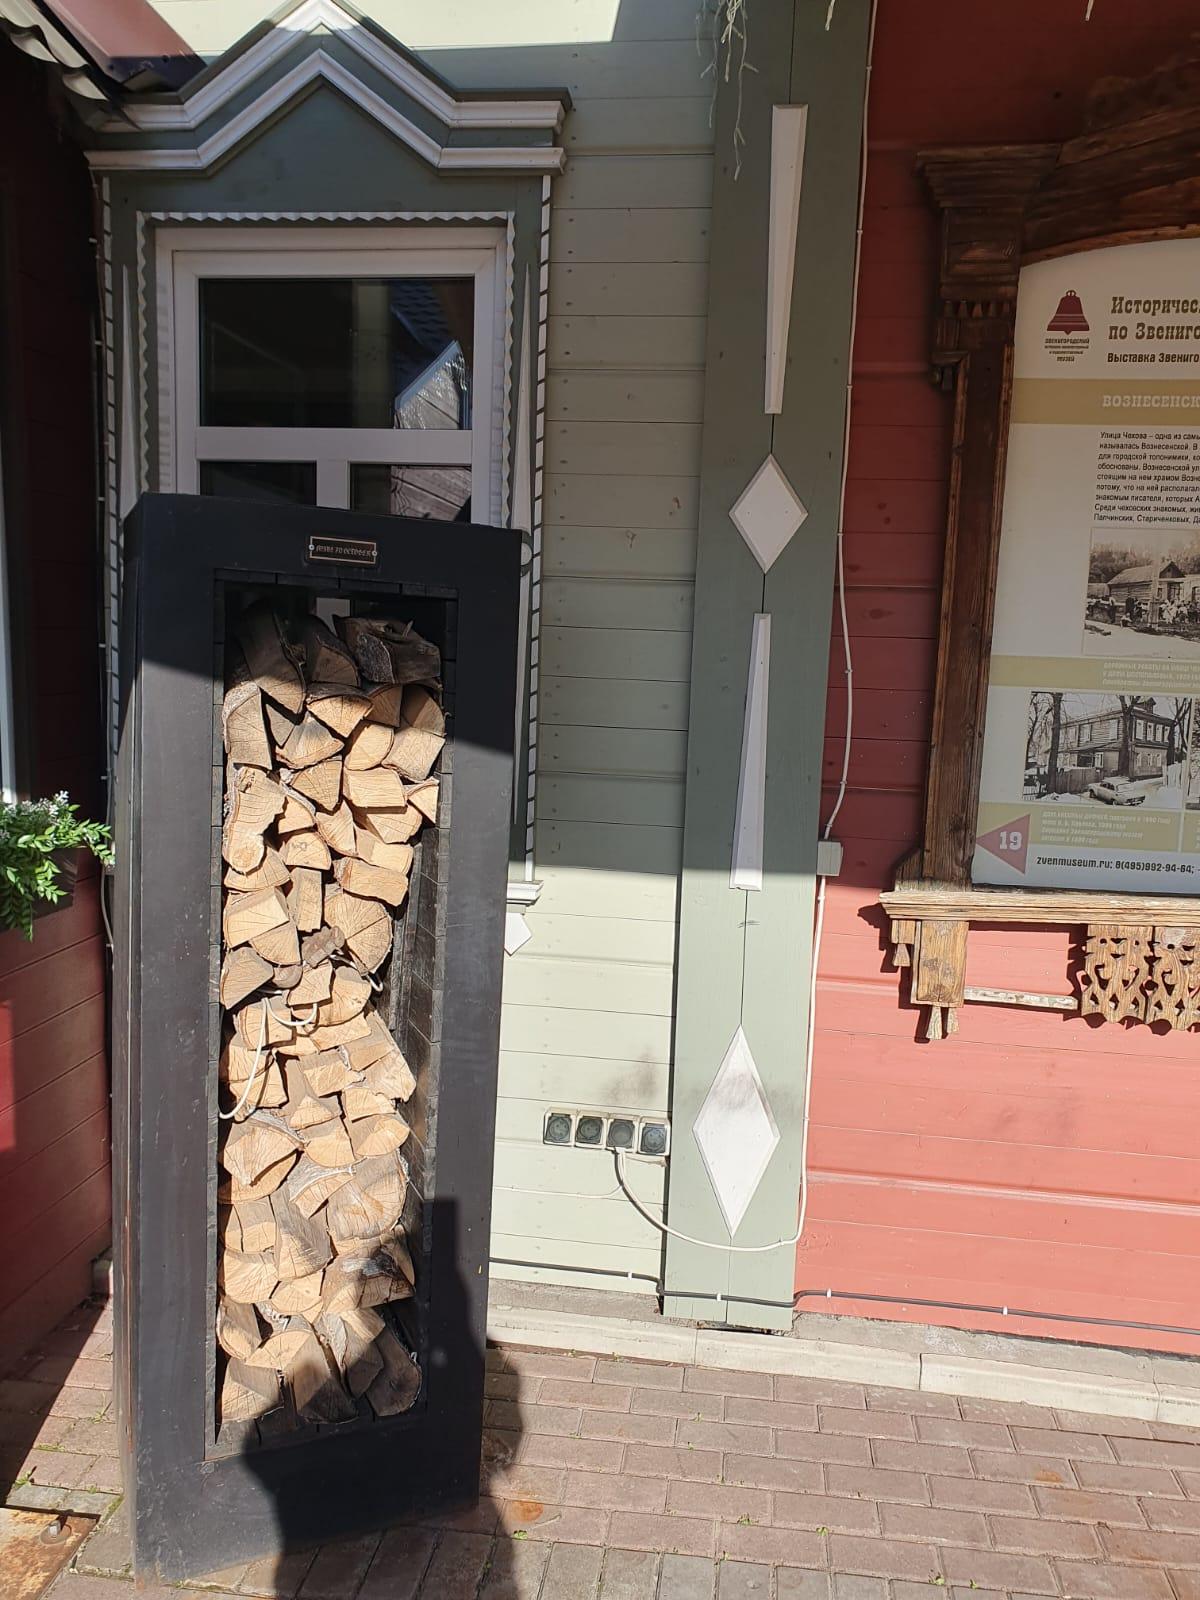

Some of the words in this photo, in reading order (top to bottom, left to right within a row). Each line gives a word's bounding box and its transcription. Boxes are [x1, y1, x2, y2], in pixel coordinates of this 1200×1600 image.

[1110, 296, 1200, 316] Историчес
[1108, 325, 1128, 340] по
[1135, 322, 1200, 340] Звениго
[1107, 352, 1156, 363] Выставка
[1158, 352, 1200, 363] Звениго
[1112, 453, 1146, 461] городской
[1095, 503, 1116, 511] Среди
[999, 831, 1023, 851] 19
